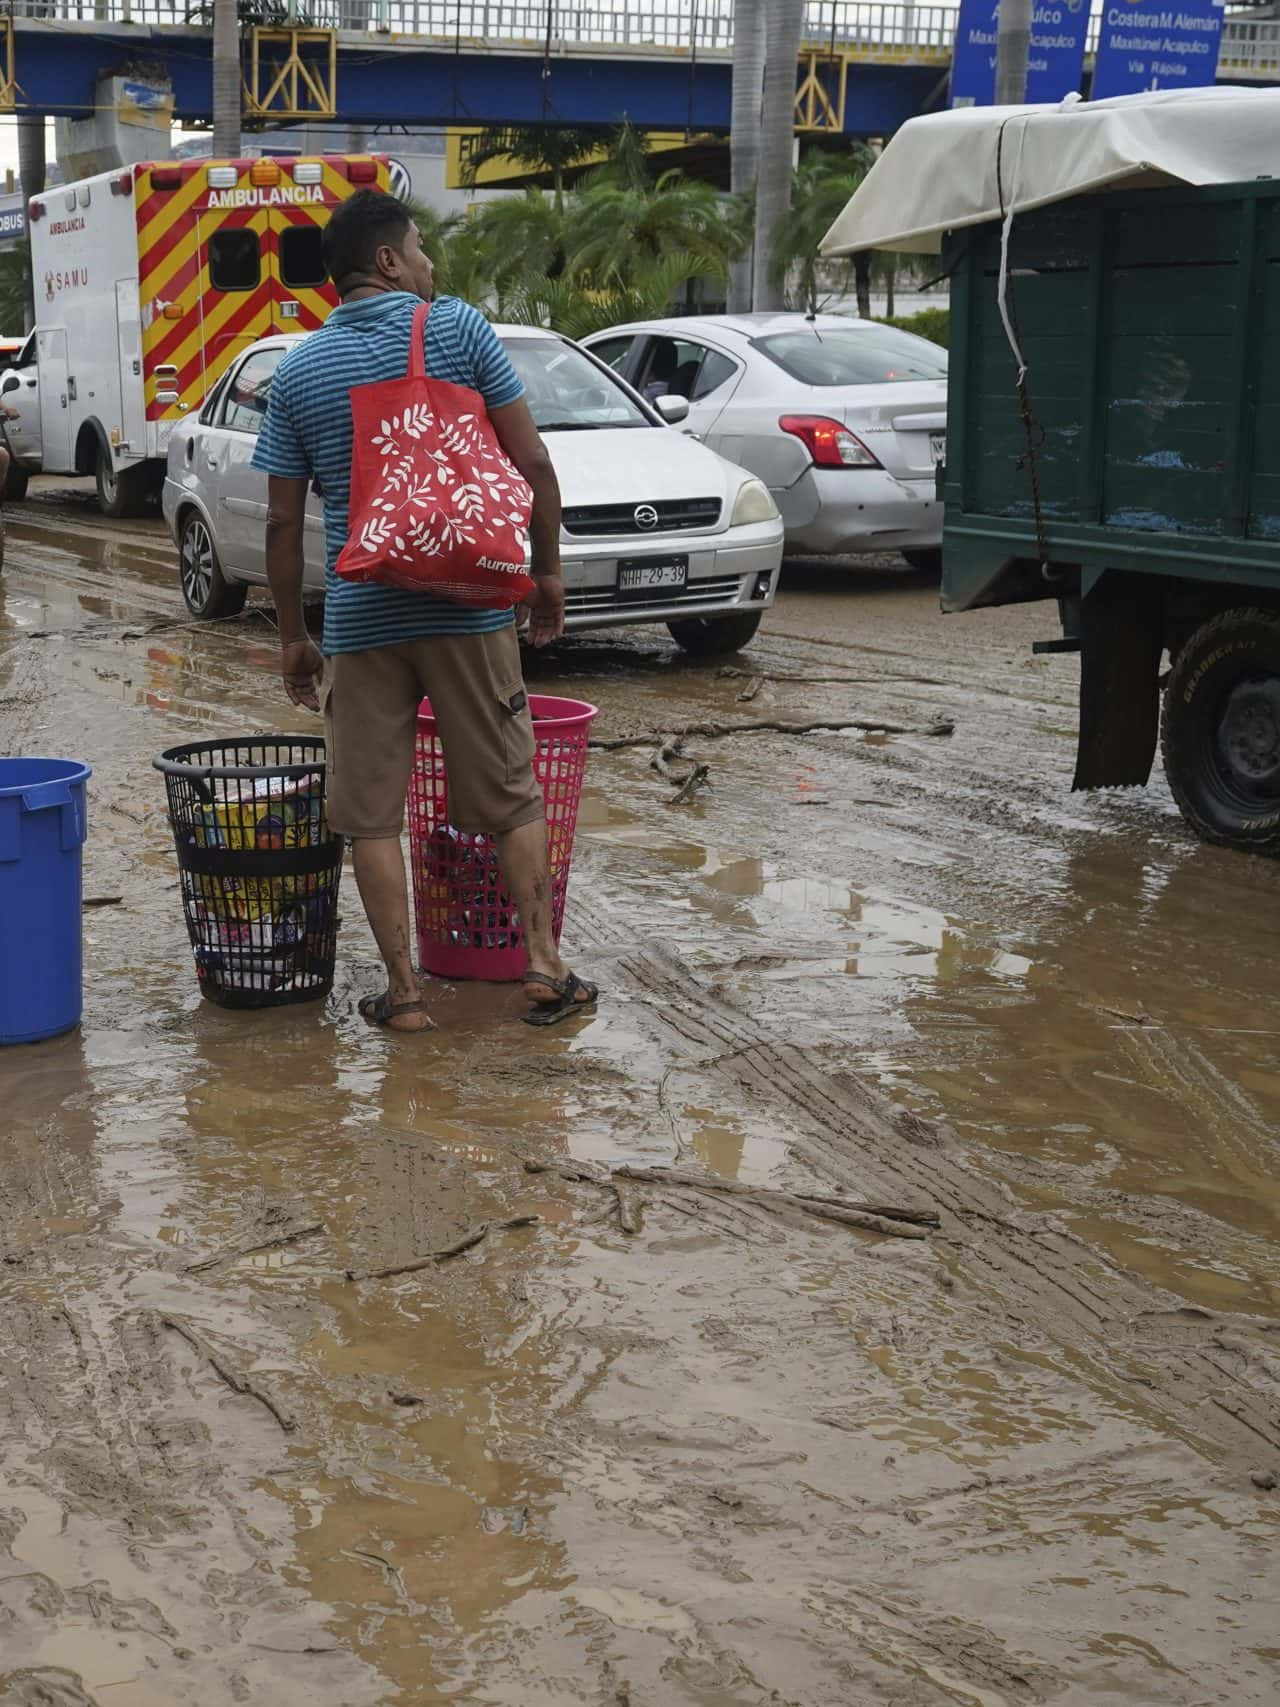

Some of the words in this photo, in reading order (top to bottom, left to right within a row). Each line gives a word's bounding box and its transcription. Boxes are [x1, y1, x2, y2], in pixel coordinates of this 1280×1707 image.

[991, 4, 1061, 24] Aulco
[1107, 8, 1160, 28] Costera
[1031, 33, 1075, 49] capulco
[1162, 37, 1209, 55] Acapulco
[207, 184, 325, 208] AMBULANCIA
[49, 217, 86, 236] AMBULANCIA
[55, 266, 89, 291] SAMU
